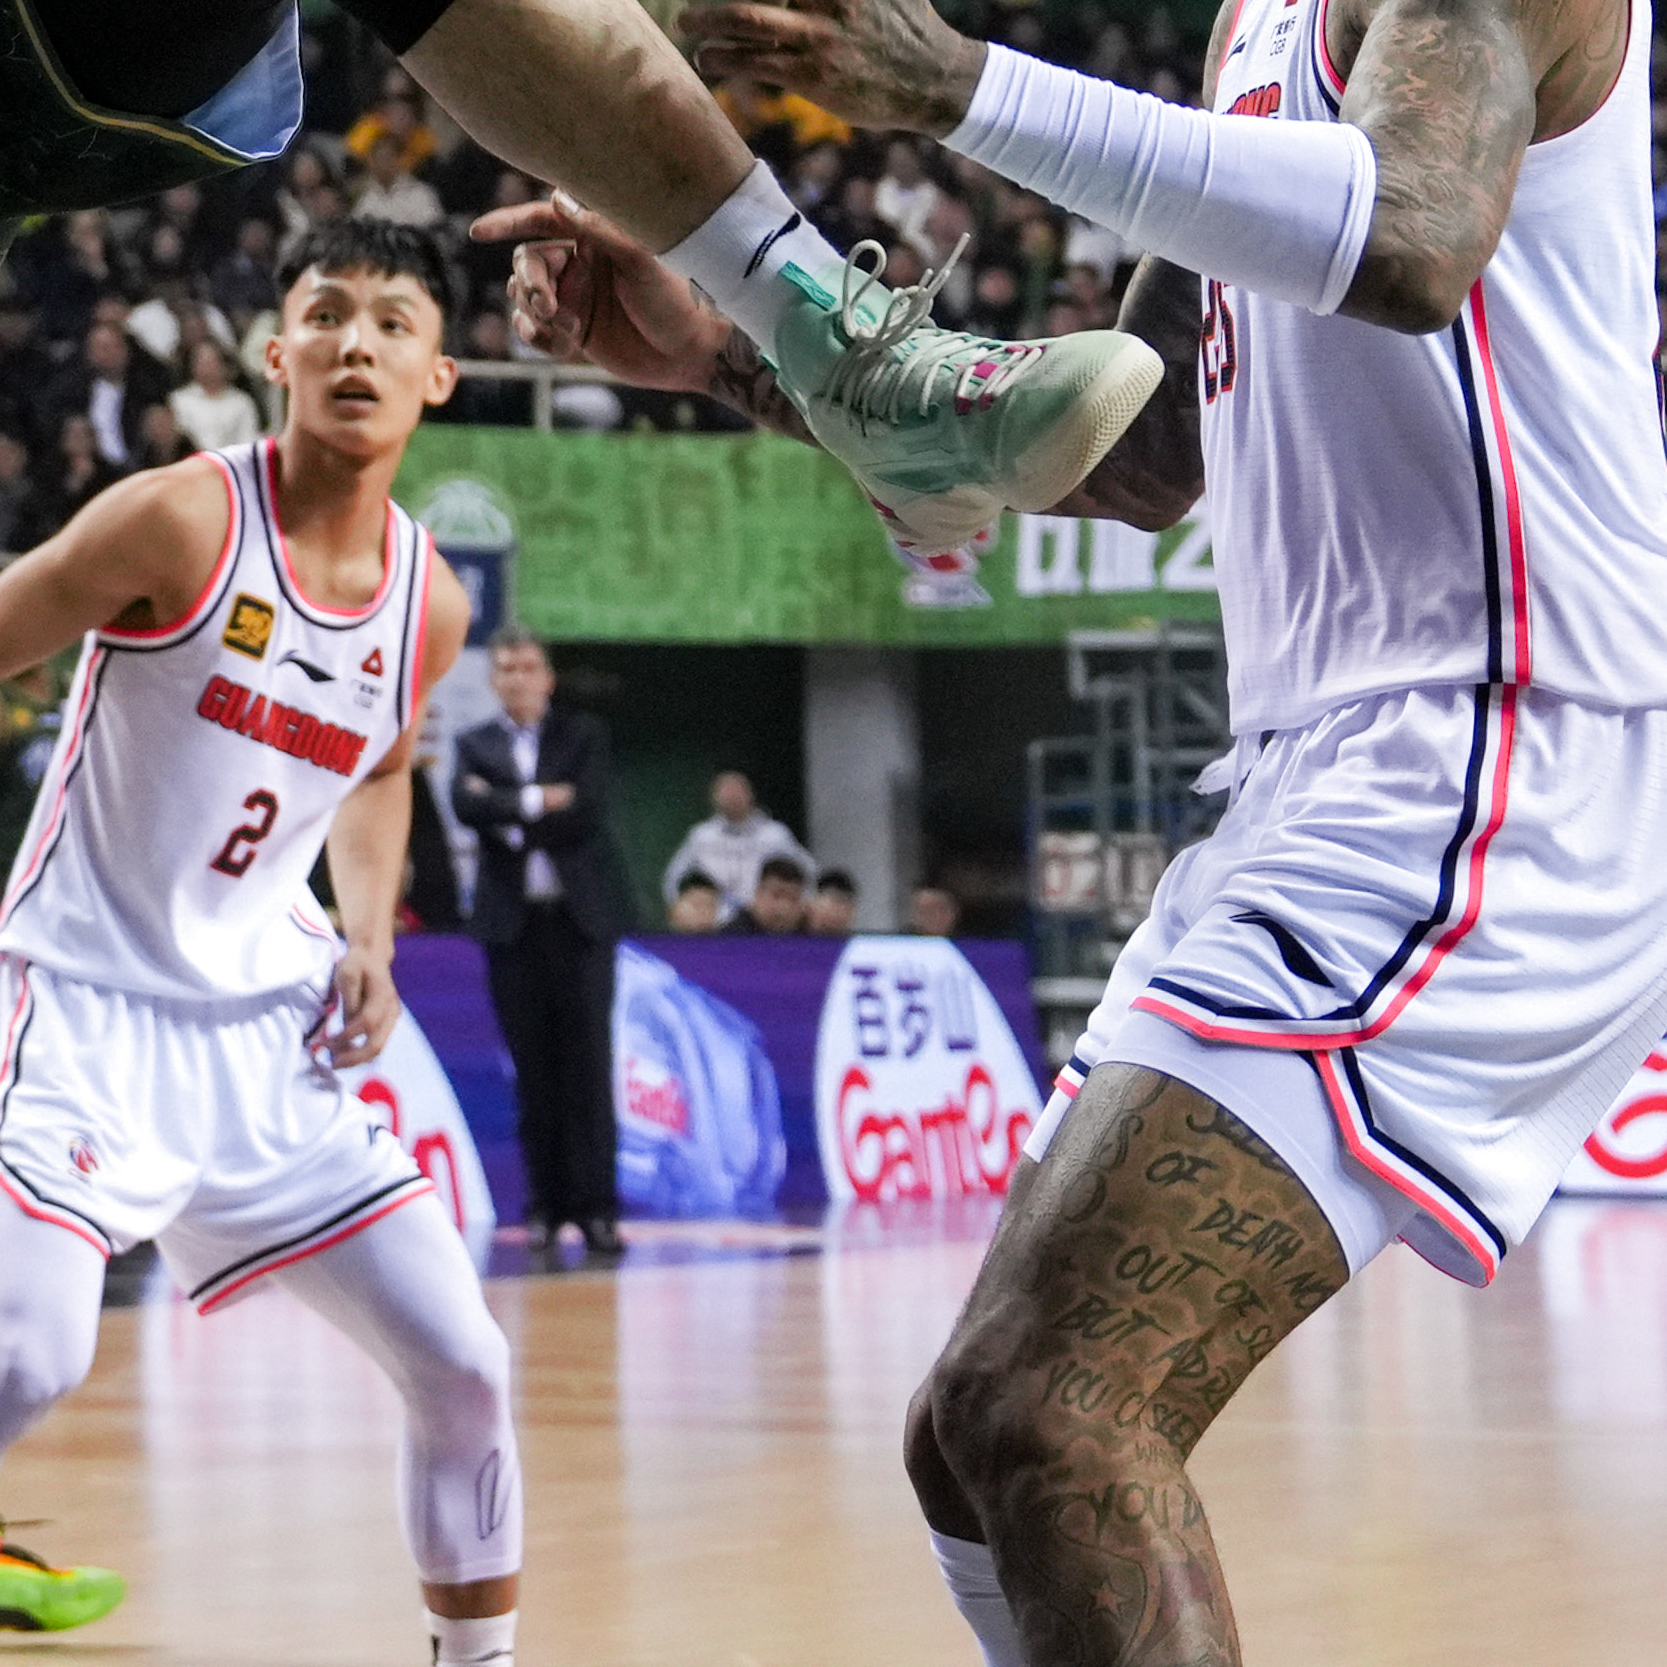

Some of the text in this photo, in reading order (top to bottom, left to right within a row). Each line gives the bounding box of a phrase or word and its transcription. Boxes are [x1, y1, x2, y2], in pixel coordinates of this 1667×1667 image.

[196, 673, 370, 778] GUANGDONG
[210, 788, 280, 879] 2
[851, 966, 980, 1058] 百岁山
[1115, 1245, 1227, 1295] OUT
[1050, 1293, 1172, 1347] BUT
